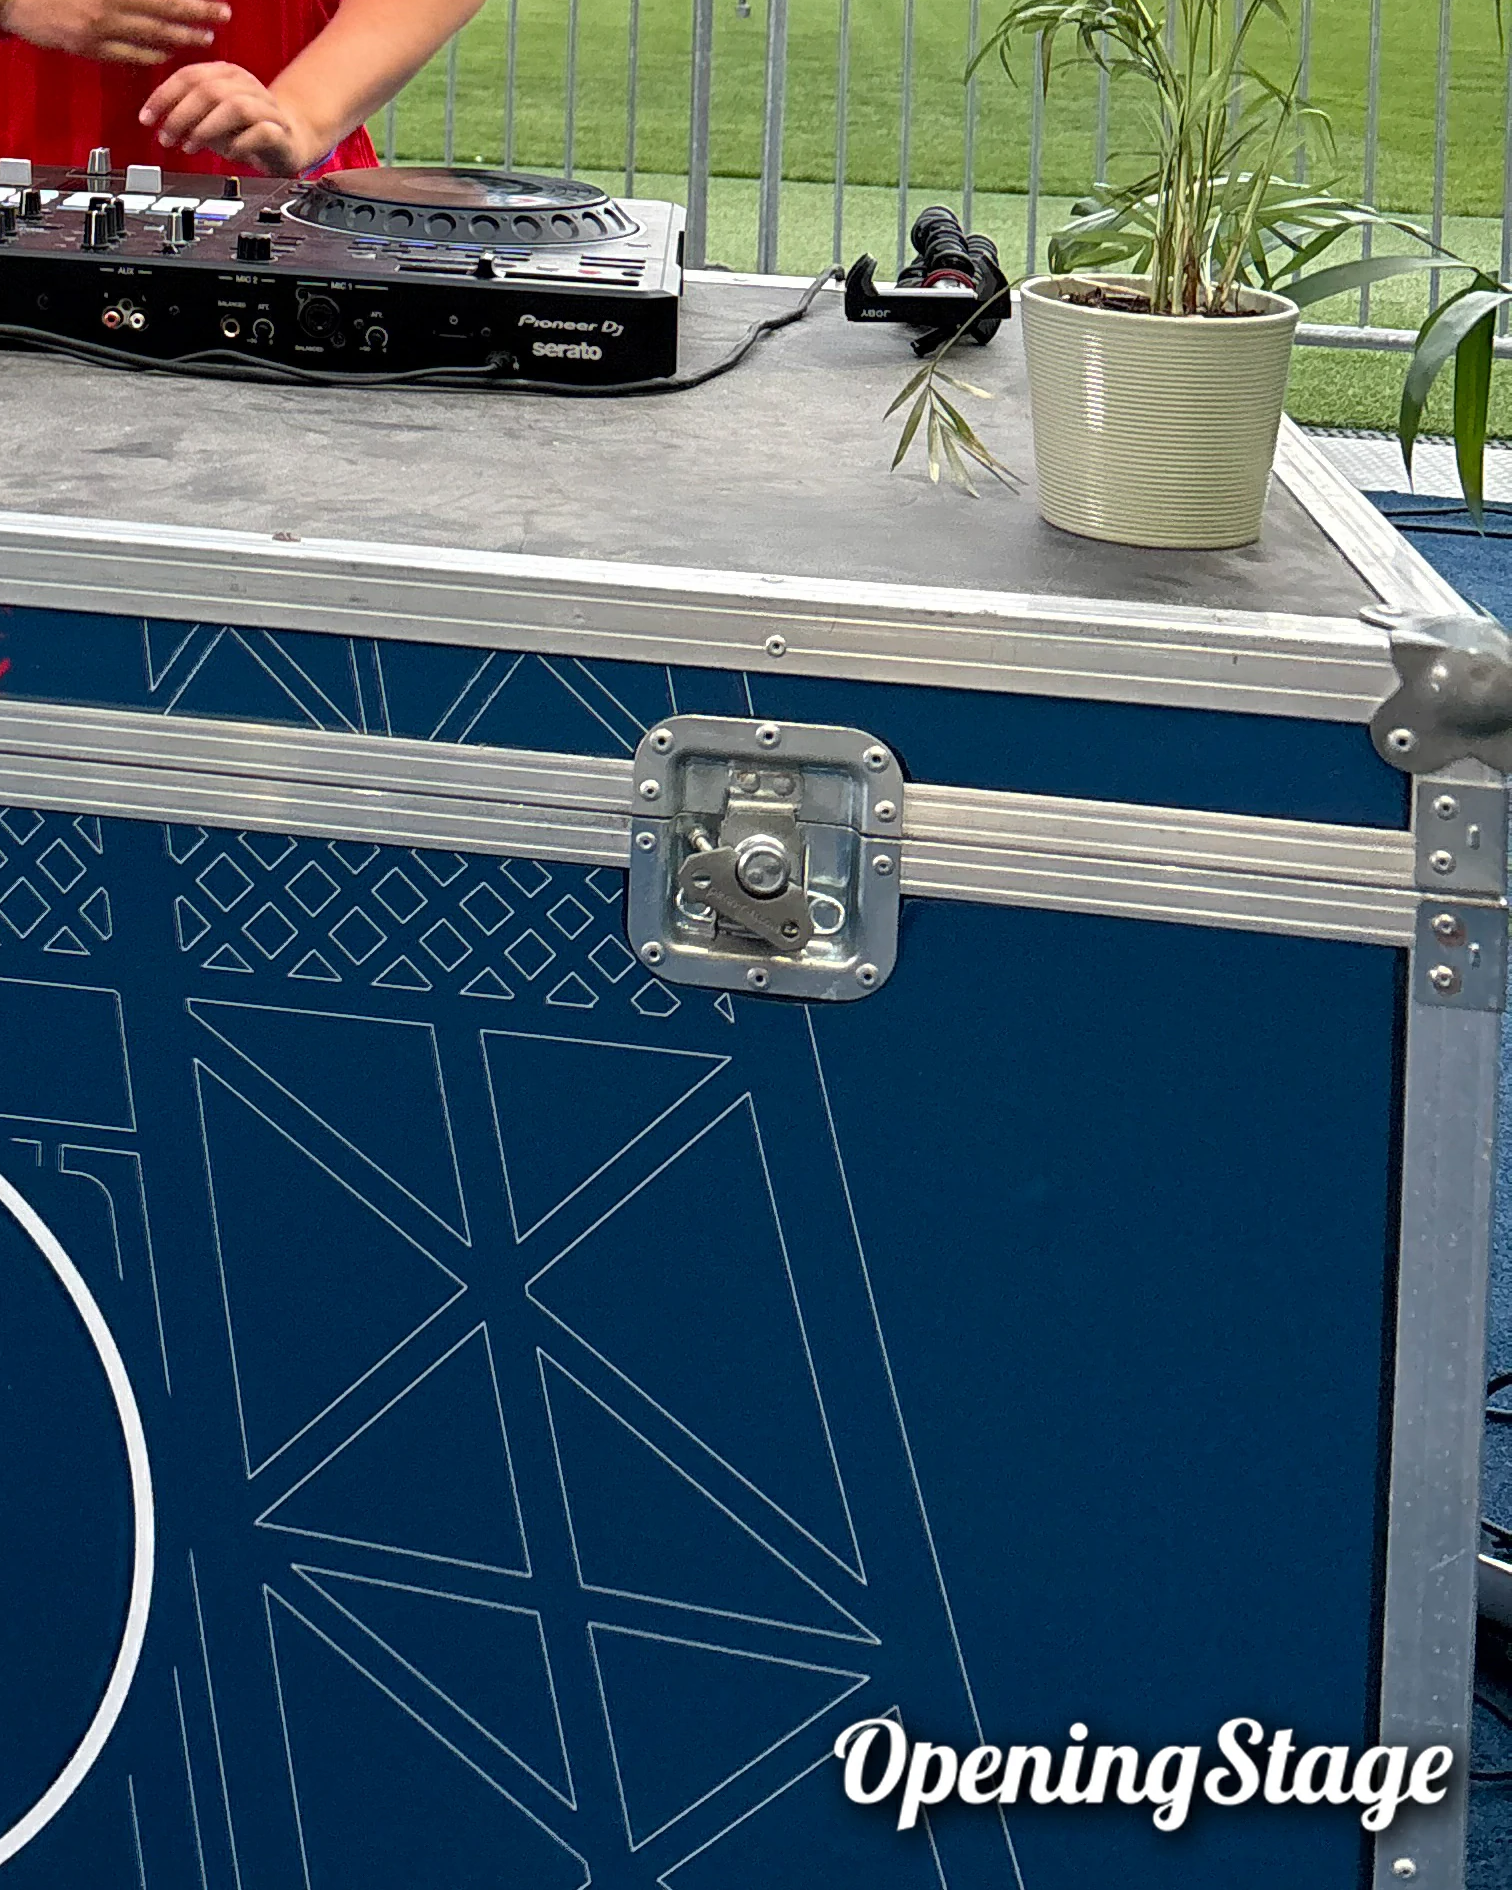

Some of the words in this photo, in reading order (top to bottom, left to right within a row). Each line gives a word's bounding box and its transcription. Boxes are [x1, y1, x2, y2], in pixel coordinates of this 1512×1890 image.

[117, 266, 135, 276] AUX
[518, 314, 598, 332] Pioneer
[532, 341, 603, 361] serato
